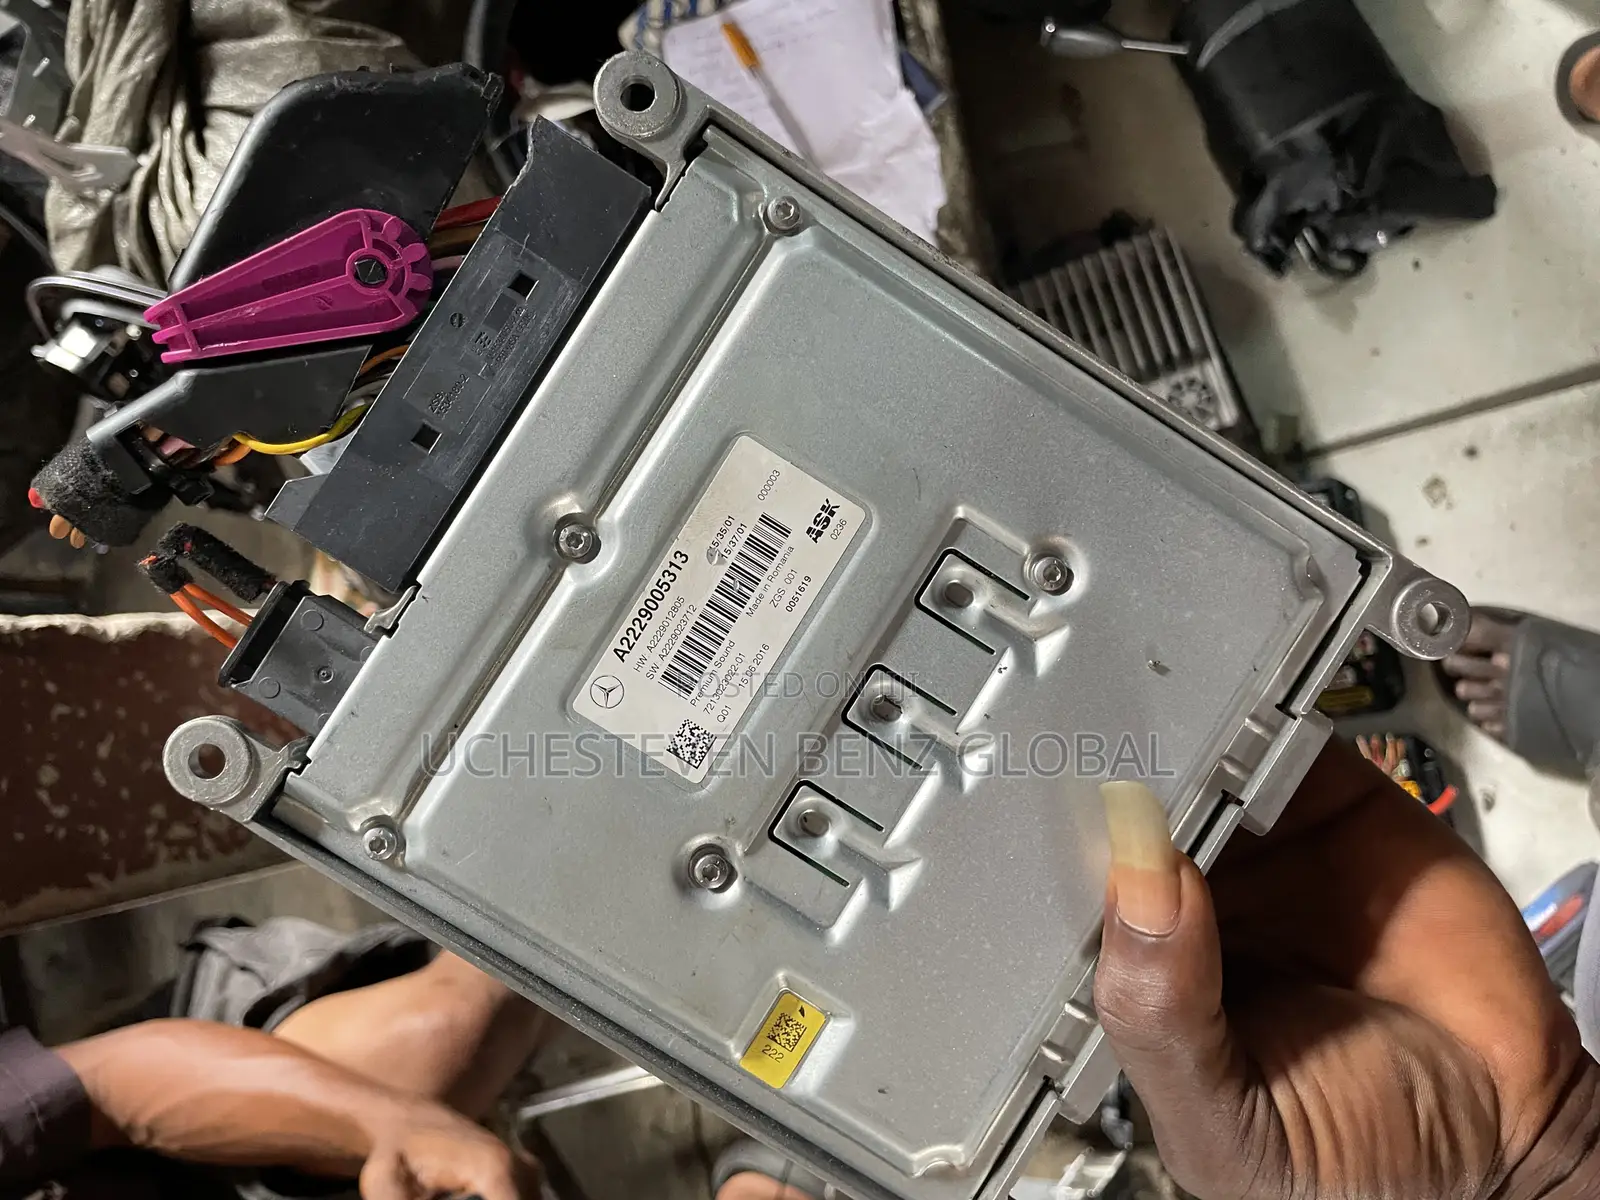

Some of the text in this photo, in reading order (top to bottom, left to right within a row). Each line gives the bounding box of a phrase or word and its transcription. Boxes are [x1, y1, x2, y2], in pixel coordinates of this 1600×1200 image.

[757, 469, 780, 500] 000003
[805, 498, 840, 543] ASK
[829, 518, 847, 540] 0236
[745, 546, 794, 617] Made in Romania
[783, 568, 797, 584] 001
[785, 575, 811, 612] 0051619
[612, 550, 688, 663] A2229005313
[646, 595, 684, 653] A2229012805
[658, 604, 697, 661] A2229023712
[689, 639, 735, 707] Premium Sound
[702, 652, 745, 714] 7213023022-01
[716, 704, 731, 722] Q01
[760, 1044, 785, 1063] 222
